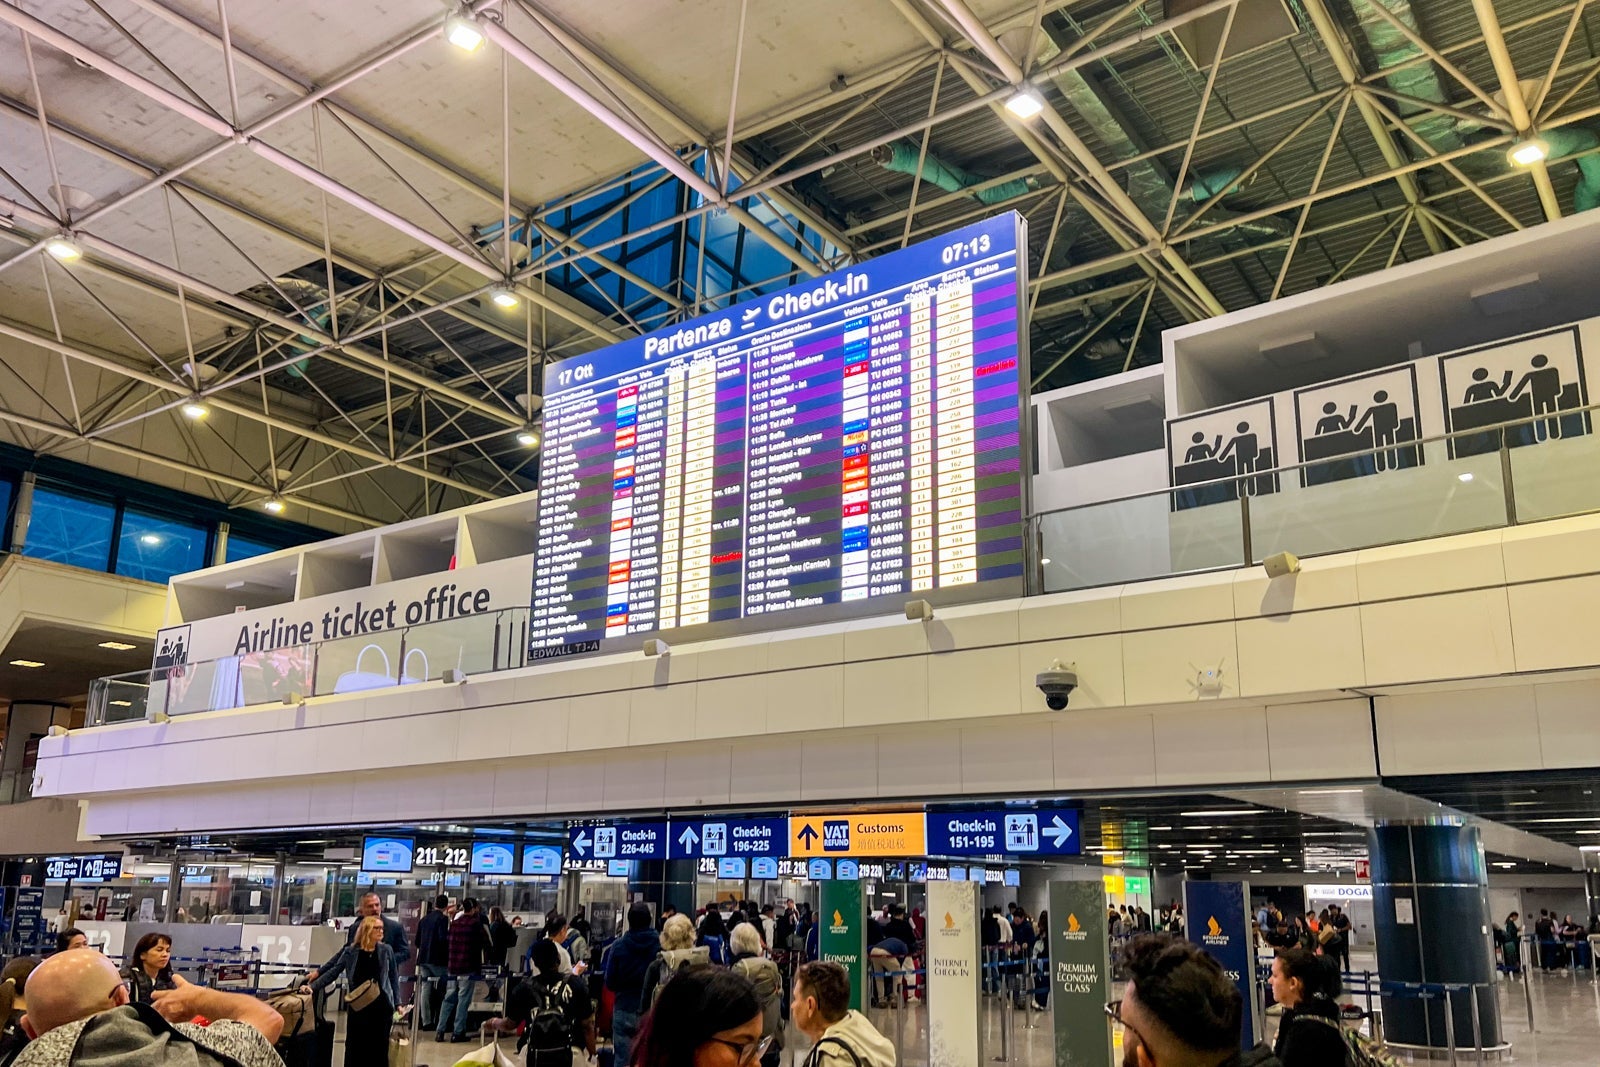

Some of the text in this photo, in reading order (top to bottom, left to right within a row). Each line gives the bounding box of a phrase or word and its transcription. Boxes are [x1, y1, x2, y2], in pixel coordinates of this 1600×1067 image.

[942, 234, 991, 264] 07:13
[644, 272, 869, 360] Partenze Check-in
[558, 363, 593, 385] 17 Ott
[767, 541, 790, 553] London
[234, 584, 491, 655] Airline ticket office
[528, 646, 573, 660] LEDWALL
[732, 825, 772, 838] Check-in
[823, 825, 849, 839] VAT
[856, 823, 904, 834] Customs
[948, 819, 997, 834] Check-in
[621, 829, 657, 841] Check-in
[621, 843, 655, 854] 226-445
[732, 839, 770, 852] 196-225
[823, 838, 849, 847] REFUND
[949, 836, 995, 848] 151-195
[415, 847, 437, 865] 211
[444, 848, 468, 866] 212
[700, 858, 714, 871] 216
[778, 861, 790, 874] 217
[793, 861, 806, 875] 218
[859, 864, 870, 877] 219
[870, 864, 882, 878] 220
[926, 867, 937, 879] 221
[936, 867, 947, 879] 222
[824, 953, 857, 963] ECONOMY
[934, 958, 968, 969] INTERNET
[934, 967, 969, 976] CHECK-IN
[1058, 962, 1096, 973] PREMIUM
[1056, 972, 1098, 983] ECONOMY
[1064, 982, 1091, 993] CLASS
